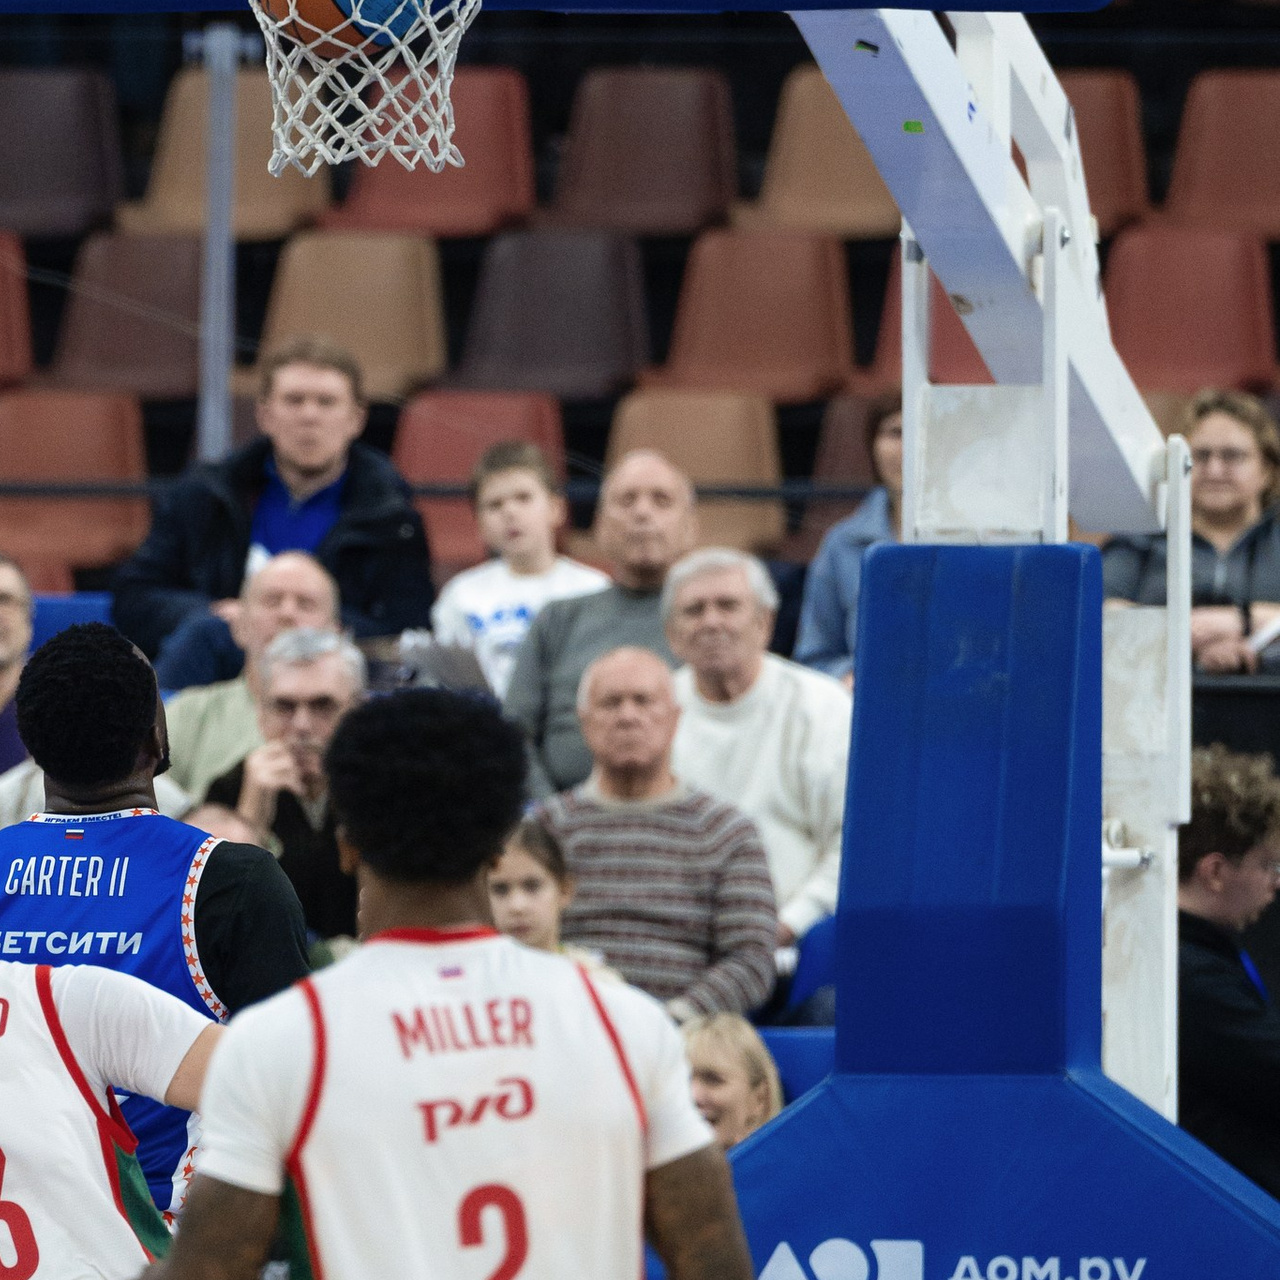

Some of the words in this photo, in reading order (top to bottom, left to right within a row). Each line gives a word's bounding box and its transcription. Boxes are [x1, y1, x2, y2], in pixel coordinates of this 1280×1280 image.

[4, 856, 101, 897] CARTER
[107, 856, 130, 897] II
[390, 998, 537, 1060] MILLER
